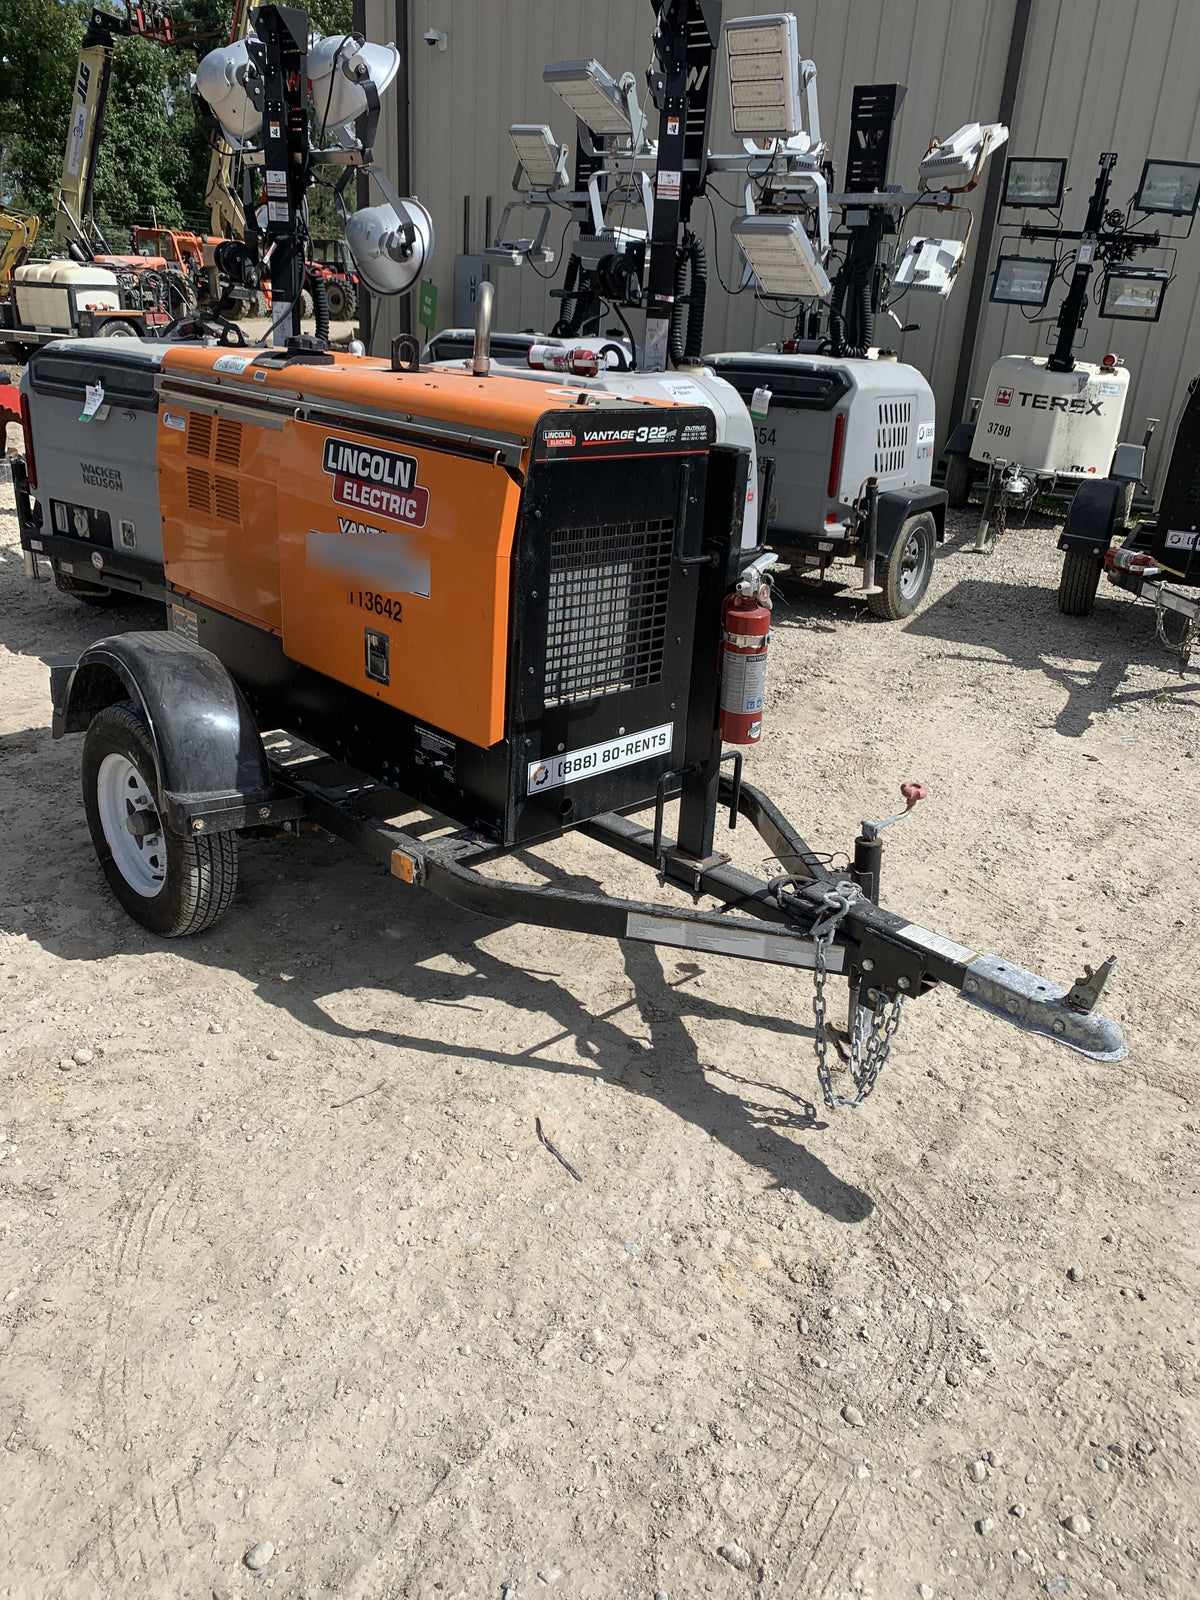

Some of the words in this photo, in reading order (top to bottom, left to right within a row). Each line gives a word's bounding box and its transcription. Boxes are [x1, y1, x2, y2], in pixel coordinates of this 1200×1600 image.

[77, 61, 91, 105] JLG
[1018, 391, 1104, 416] TEREX
[583, 430, 635, 441] VANTAGE
[635, 426, 668, 443] 322
[987, 422, 1011, 438] 3798
[80, 463, 121, 481] WACKER
[327, 444, 412, 489] LINCOLN
[82, 474, 124, 492] NEUSON
[342, 481, 417, 519] ELECTRIC
[557, 753, 598, 777] (888)
[602, 733, 667, 763] 80-RENTS
